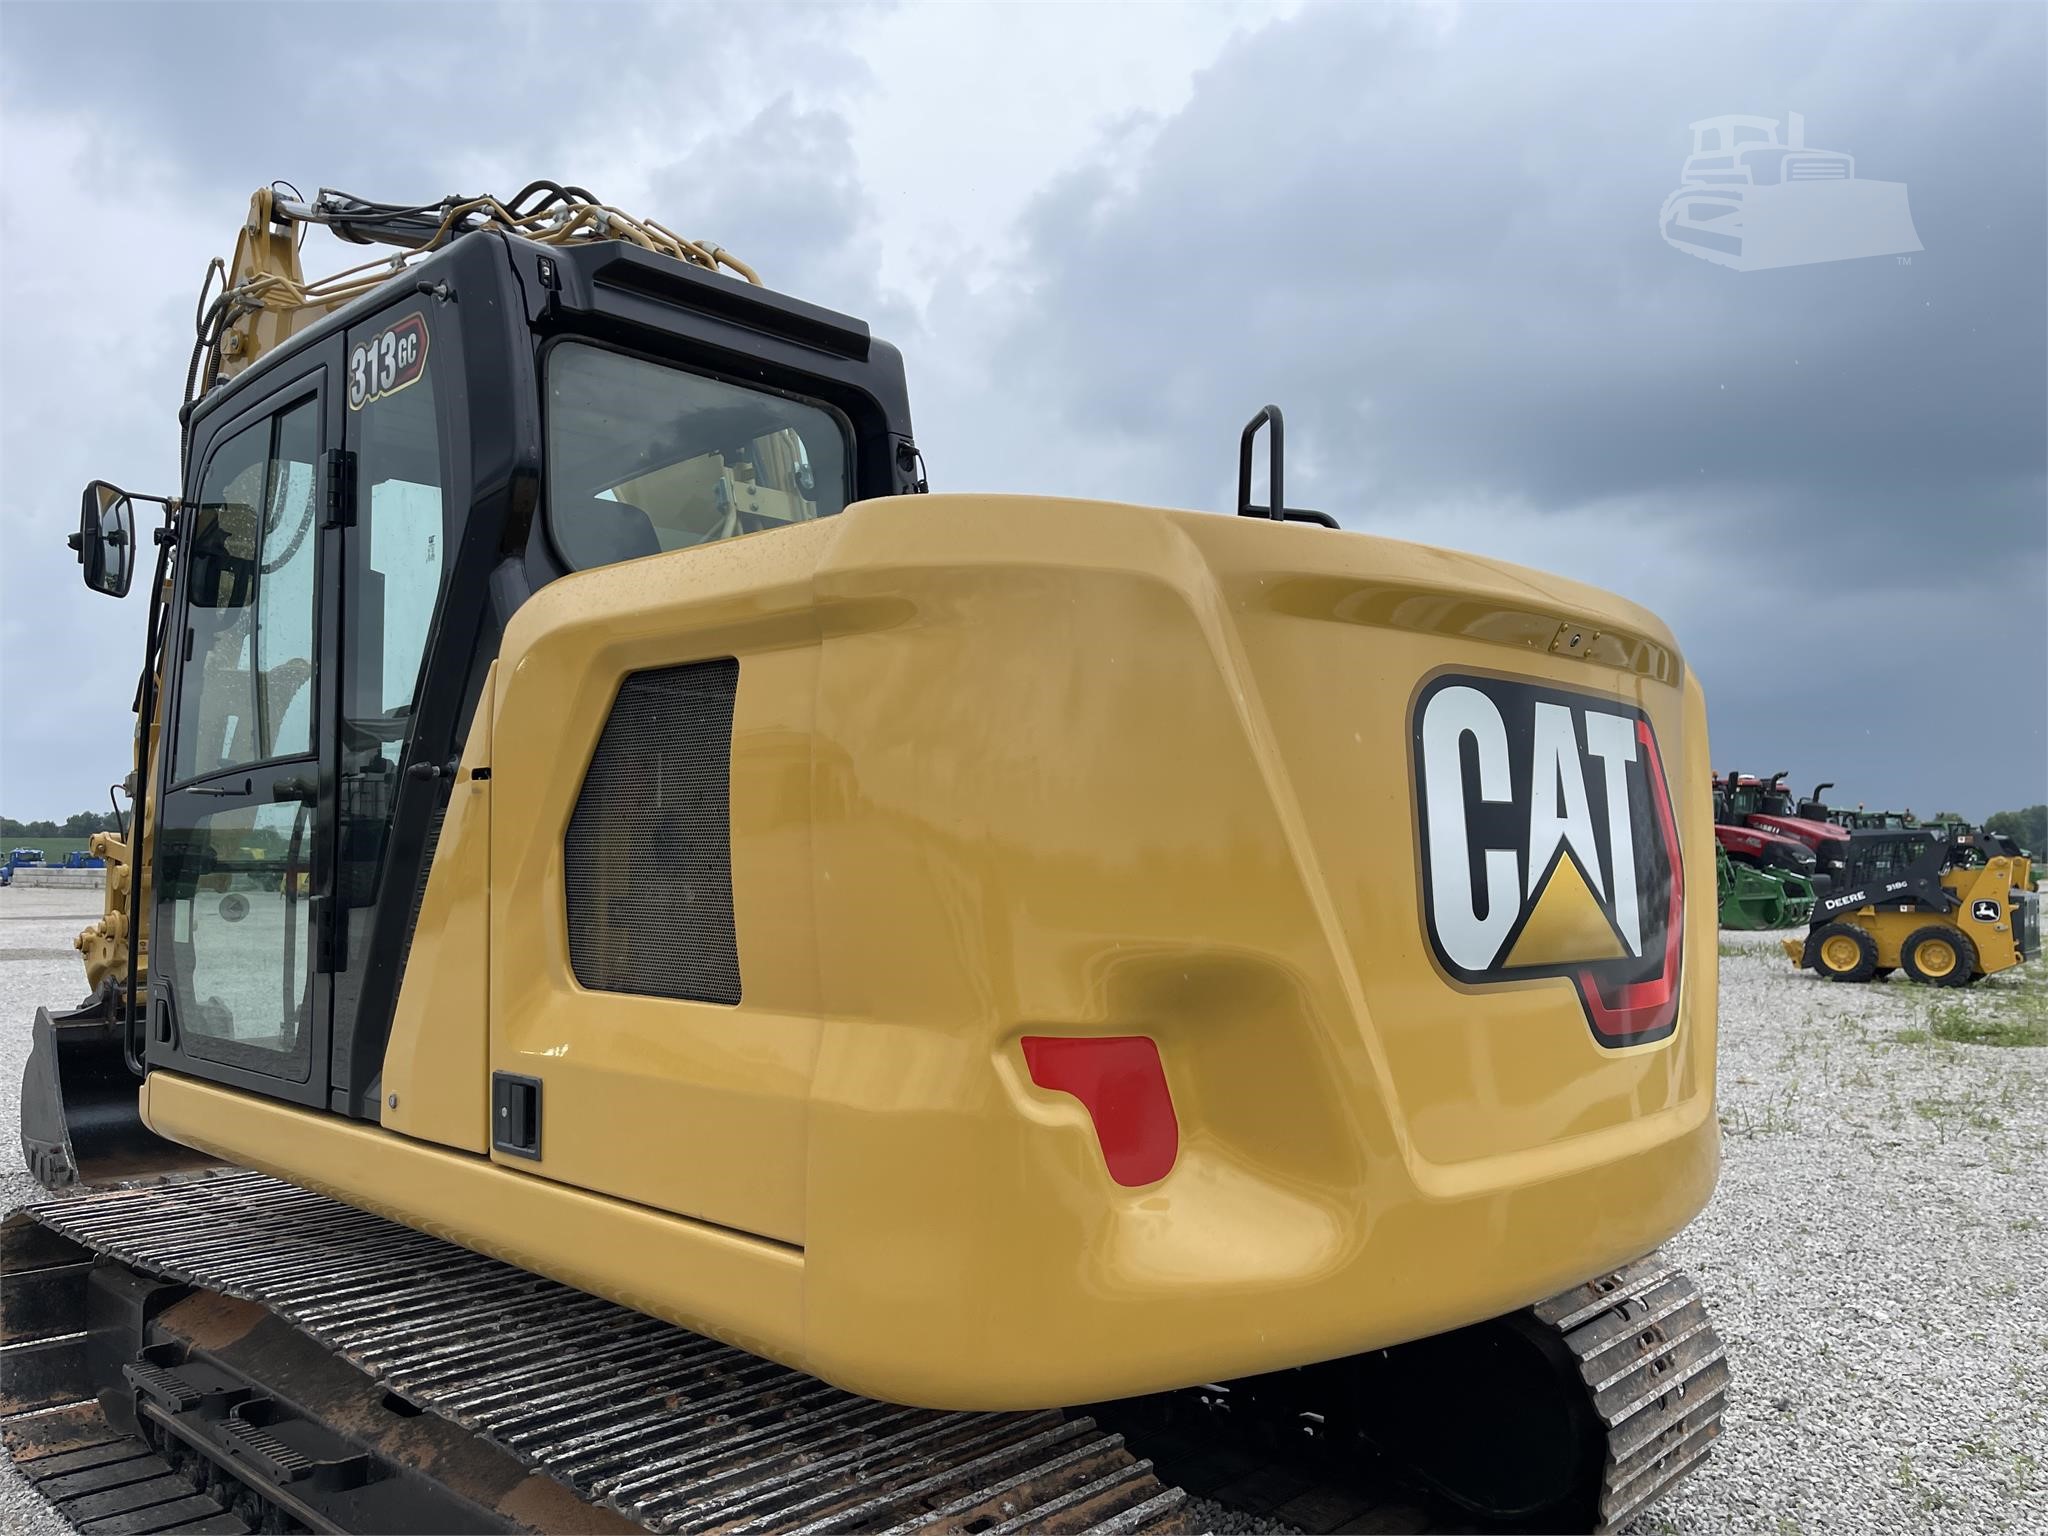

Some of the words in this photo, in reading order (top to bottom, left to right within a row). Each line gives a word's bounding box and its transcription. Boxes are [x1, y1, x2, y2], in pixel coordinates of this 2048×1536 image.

[351, 331, 396, 404] 313
[398, 333, 417, 368] GC
[1422, 685, 1643, 971] CAT
[1824, 890, 1867, 910] DEERE
[1885, 880, 1908, 892] 318G
